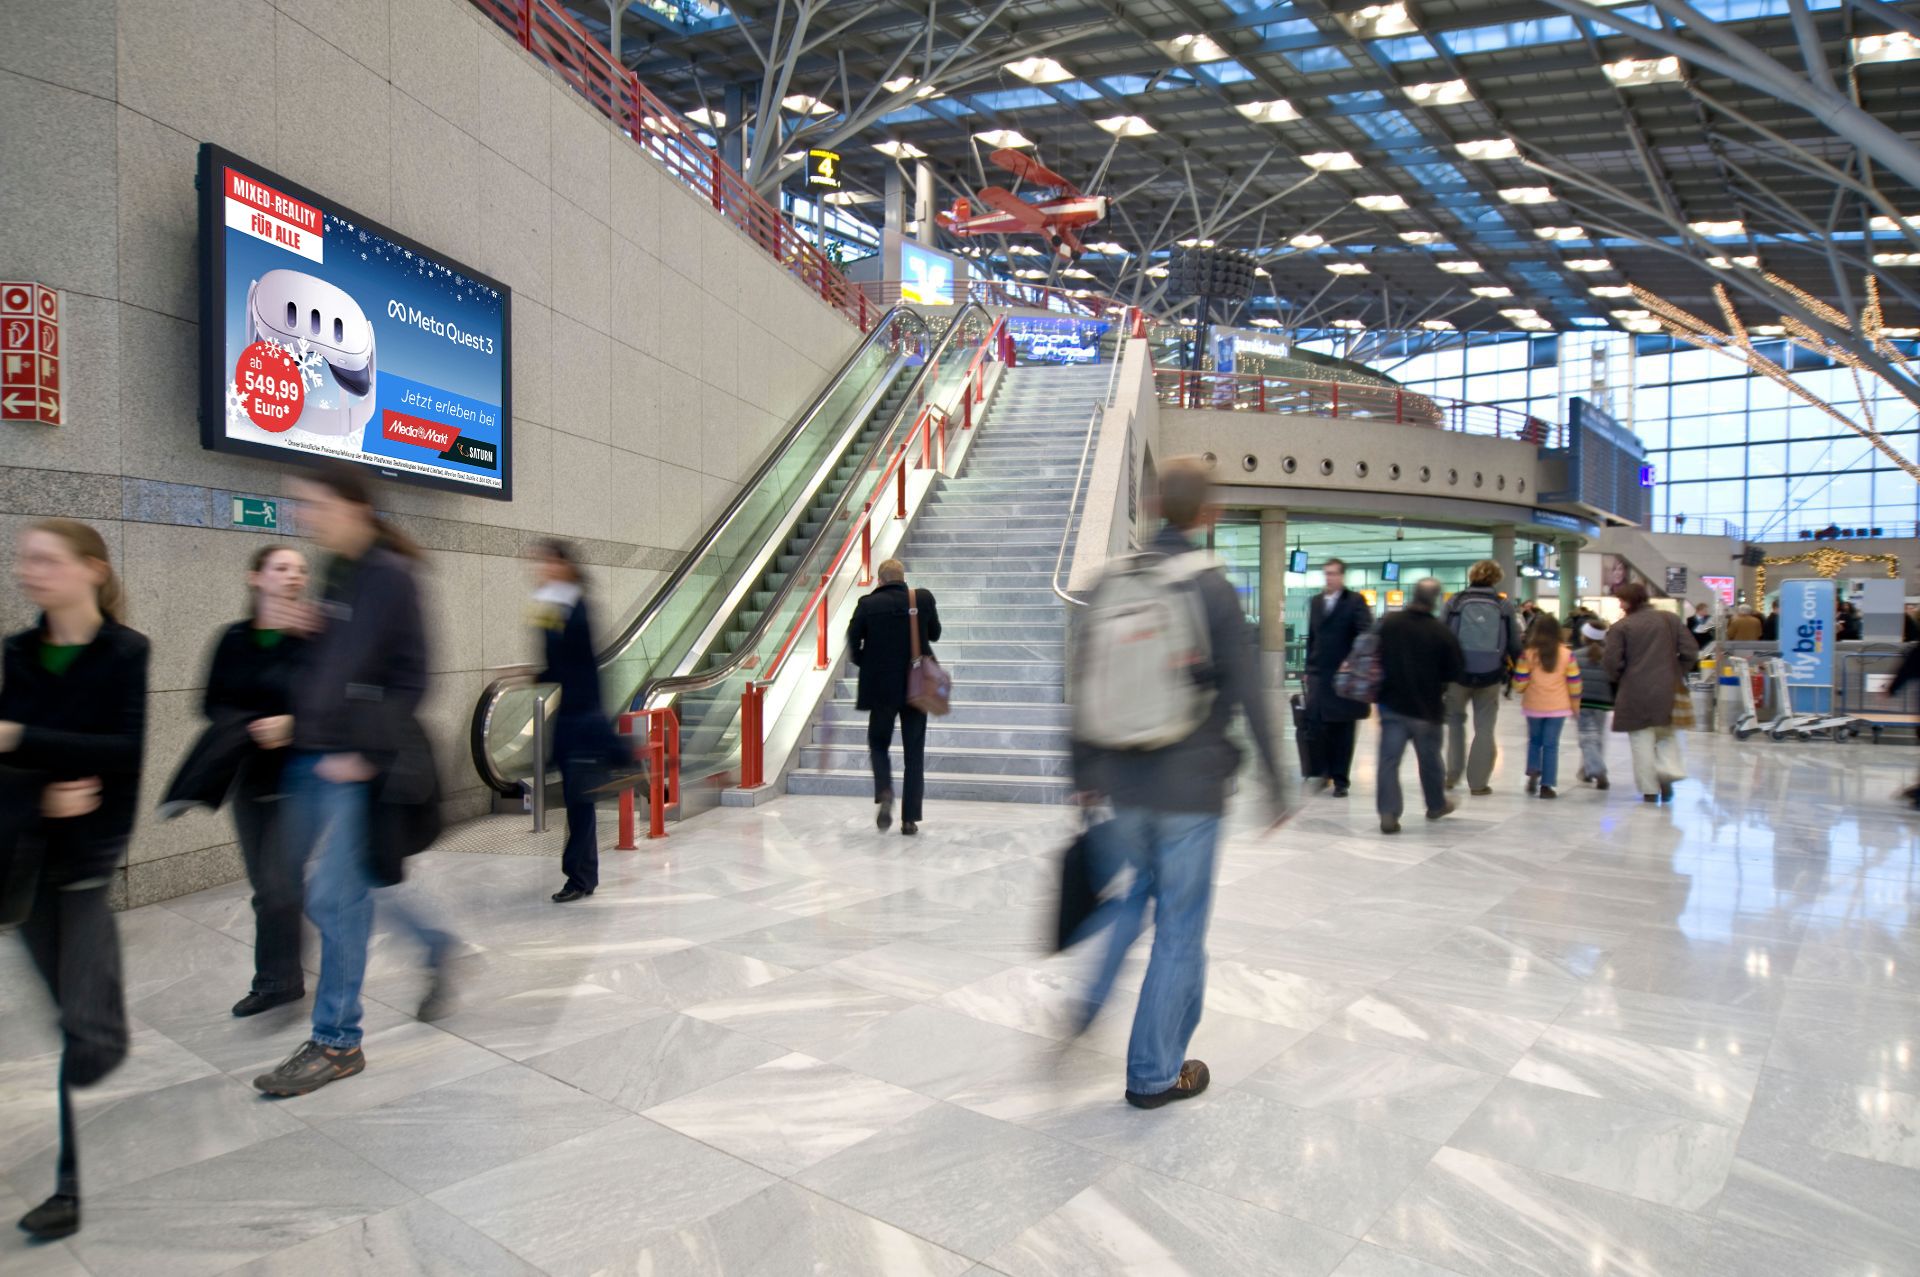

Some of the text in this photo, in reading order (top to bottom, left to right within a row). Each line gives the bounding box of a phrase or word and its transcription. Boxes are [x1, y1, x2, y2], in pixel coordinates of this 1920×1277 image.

[818, 157, 833, 177] 4
[233, 176, 316, 228] MIXED-REALITY
[251, 212, 300, 250] FÜR ALLE
[408, 306, 494, 355] Meta Quest 3
[249, 356, 263, 370] ab
[245, 370, 299, 401] 549,99
[400, 389, 496, 427] Jetzt erleben bei
[469, 446, 493, 463] SATURN
[1792, 583, 1821, 680] flybe.com
